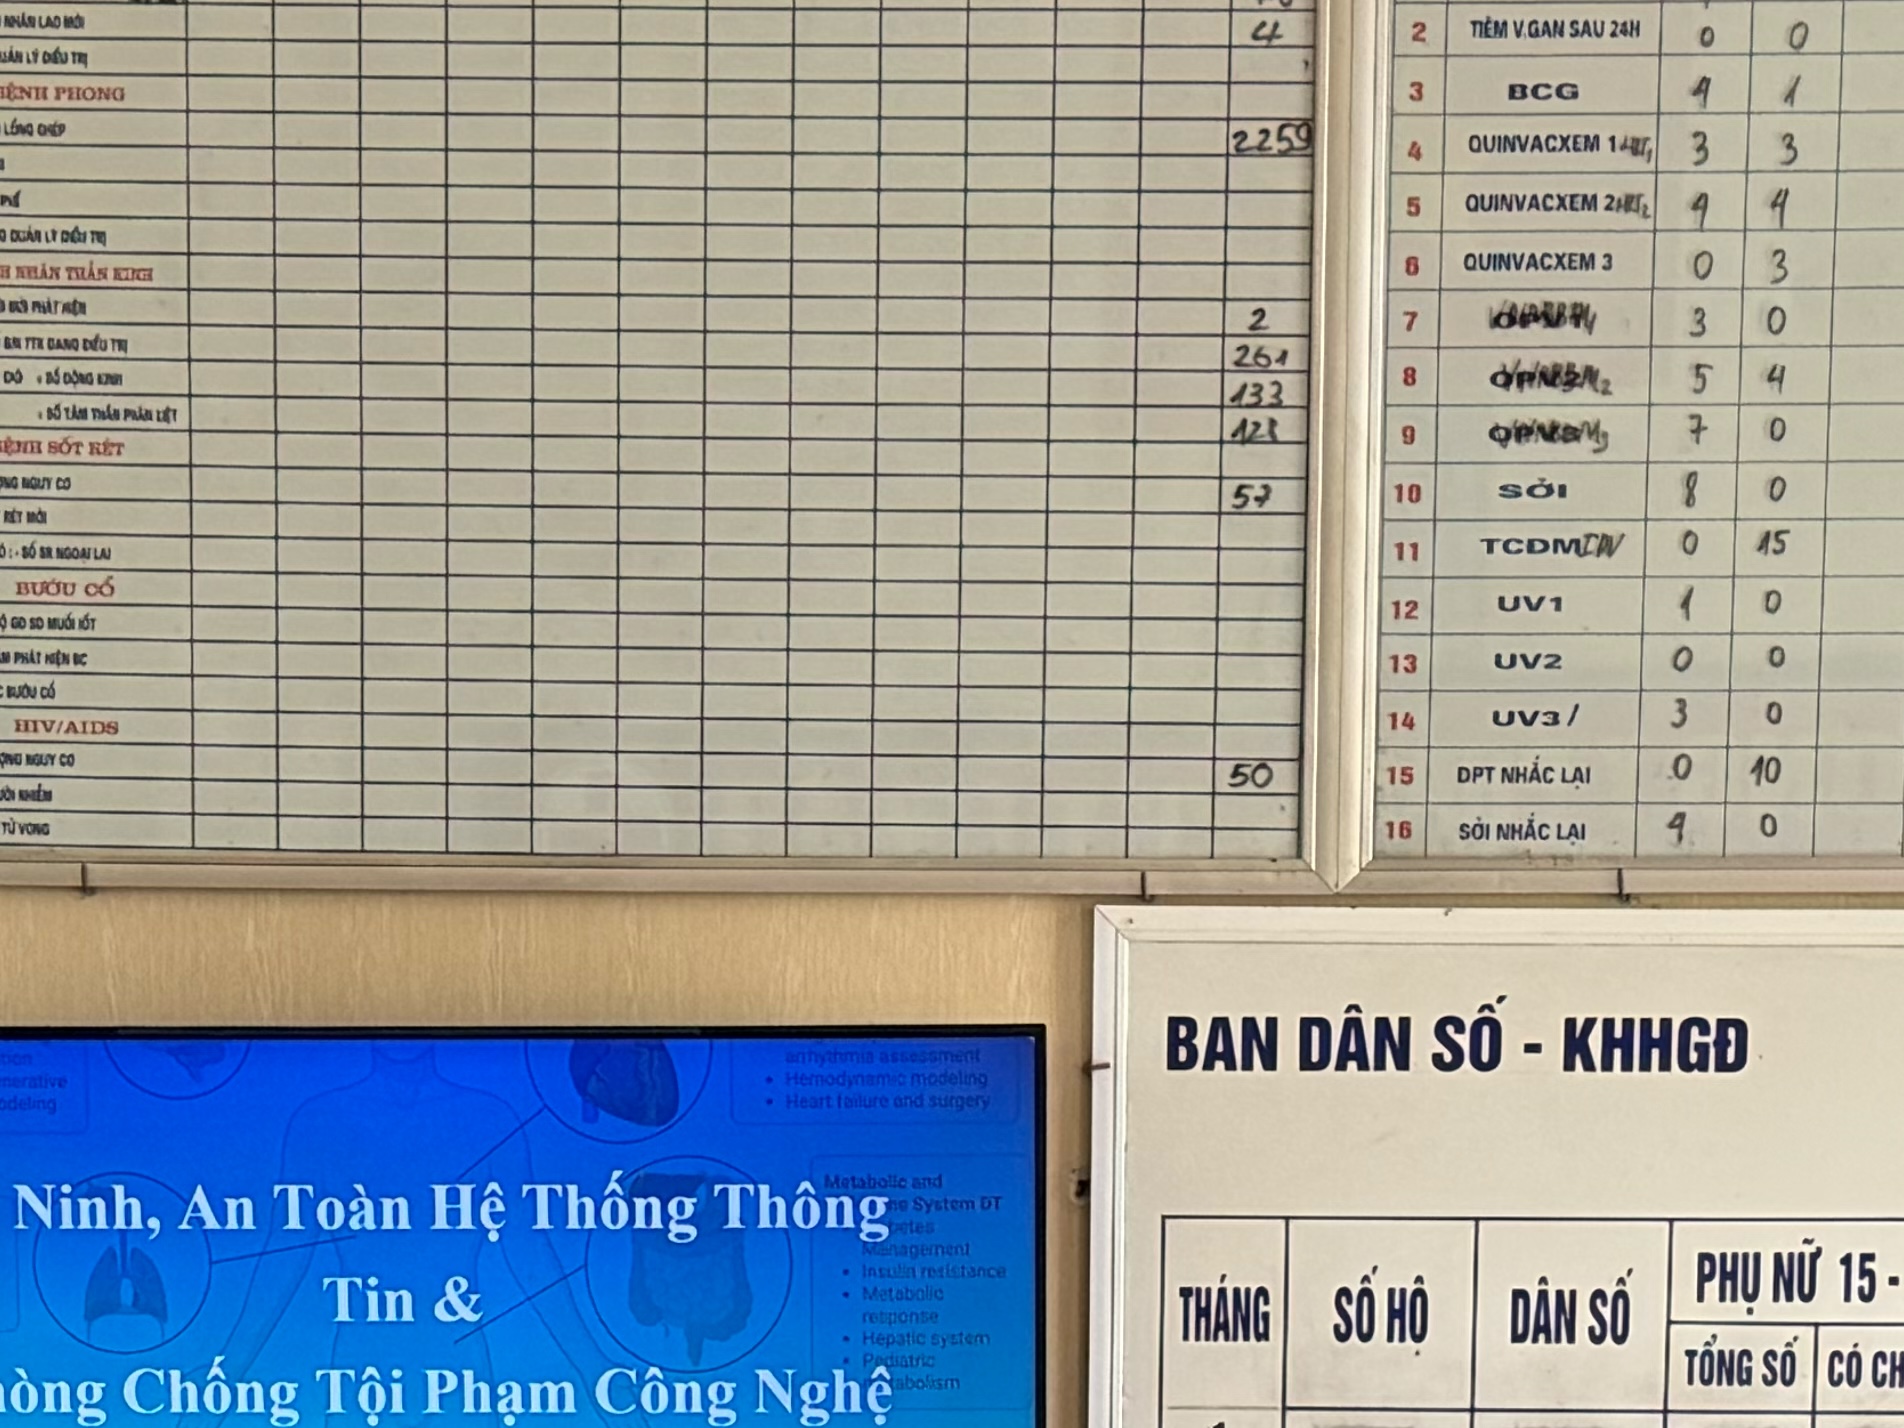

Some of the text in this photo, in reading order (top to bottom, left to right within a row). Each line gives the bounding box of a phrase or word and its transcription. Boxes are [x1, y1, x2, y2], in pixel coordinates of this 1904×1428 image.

[1569, 19, 1605, 38] SAU
[1609, 19, 1641, 38] 24H
[53, 85, 126, 102] PHONG
[1507, 82, 1580, 101] BCG
[1231, 119, 1314, 154] 2259
[1468, 133, 1600, 154] QUINVACXEM
[1464, 194, 1598, 214] QUINVACXEM
[1463, 252, 1614, 273] QUINVACXEM 3
[47, 435, 83, 456] SỐT
[1394, 478, 1568, 504] 10 SỞI
[1391, 595, 1564, 620] 12 UV1
[1391, 652, 1563, 675] 13 UV2
[13, 718, 120, 736] HIV/AIDS
[1389, 711, 1416, 732] 14
[1227, 762, 1274, 790] 50
[1387, 755, 1591, 790] 15 DPT NHẮC LẠI
[1385, 812, 1586, 847] 16 SỞI NHẮC LẠI
[1167, 995, 1749, 1074] BAN DÂN SỐ - KHHGĐ
[13, 1183, 162, 1240] Ninh,
[177, 1183, 259, 1230] An
[273, 1182, 412, 1231] Toàn
[429, 1181, 506, 1243] Hệ
[522, 1170, 699, 1243] Thống
[713, 1180, 890, 1243] Thông
[1695, 1252, 1762, 1317] PHỤ
[1772, 1238, 1823, 1304] NỮ
[1838, 1252, 1878, 1303] 15
[322, 1275, 484, 1323] Tin &
[1179, 1276, 1271, 1343] THÁNG
[1333, 1265, 1430, 1356] SỐ HỘ
[1510, 1268, 1633, 1346] DÂN SỐ
[1684, 1334, 1798, 1388] TỔNG SỐ
[1826, 1342, 1864, 1390] CÓ
[122, 1355, 299, 1428] Chống
[315, 1366, 406, 1428] Tội
[424, 1368, 577, 1427] Phạm
[595, 1366, 737, 1428] Công
[754, 1365, 893, 1428] Nghệ
